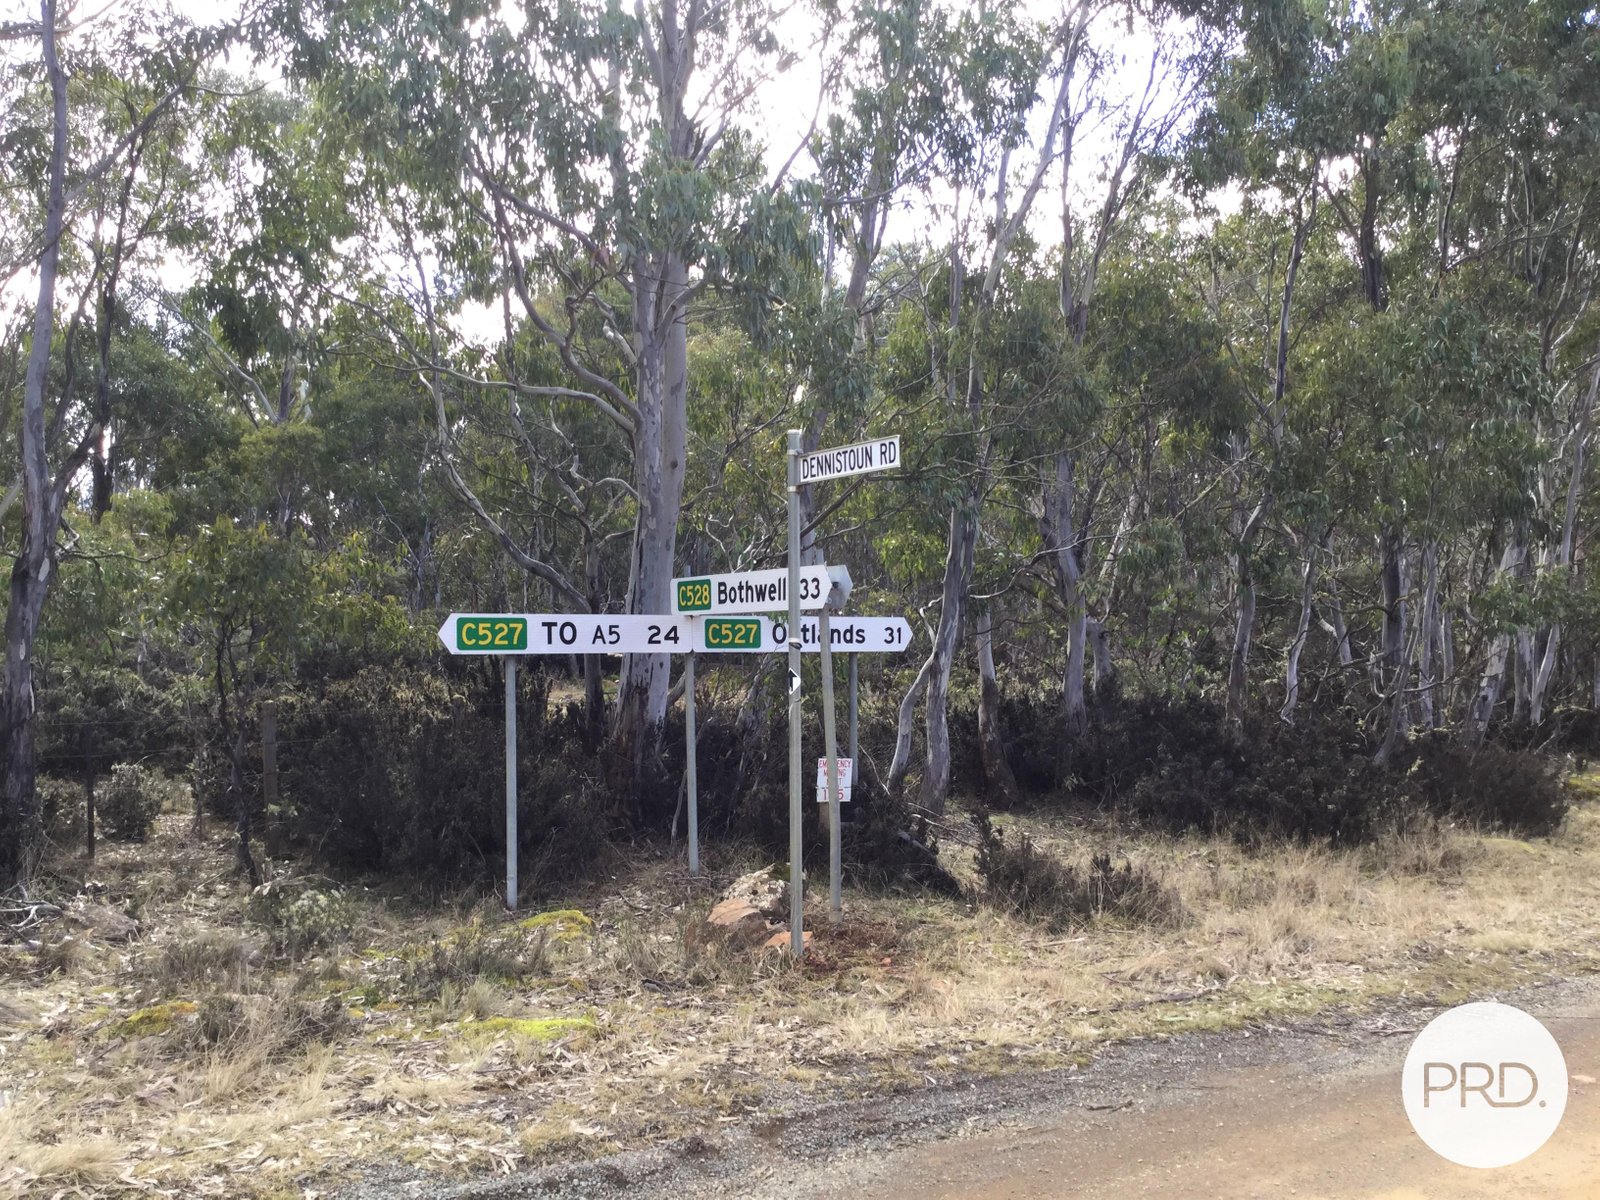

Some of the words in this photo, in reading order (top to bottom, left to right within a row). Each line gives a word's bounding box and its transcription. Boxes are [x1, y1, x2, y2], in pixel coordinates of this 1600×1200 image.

[802, 445, 873, 479] DENNISTOUN
[880, 441, 897, 466] RD
[679, 583, 710, 607] C528
[717, 576, 787, 605] Bothwell
[799, 577, 821, 600] 33
[461, 622, 524, 646] C527
[541, 621, 578, 645] TO
[591, 624, 621, 645] A5
[647, 625, 680, 645] 24
[708, 622, 758, 644] C527
[771, 622, 866, 645] Otlnds
[883, 626, 902, 645] 31
[823, 788, 844, 801] 15
